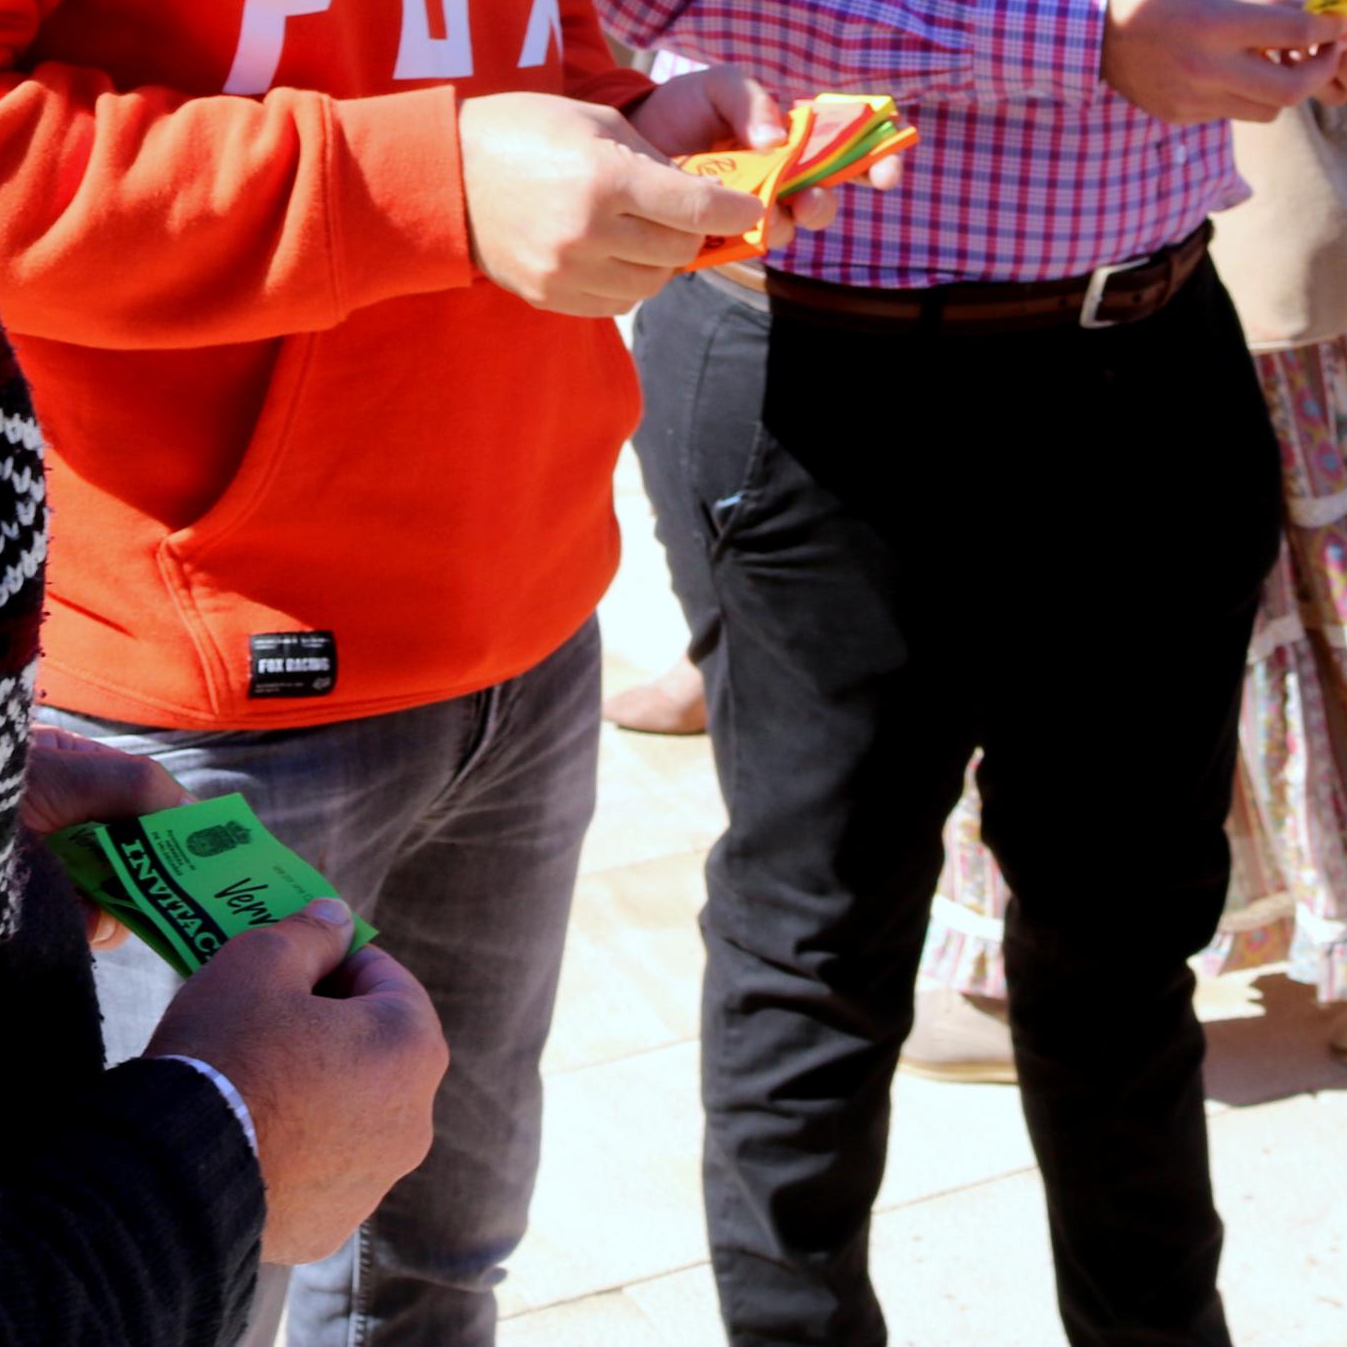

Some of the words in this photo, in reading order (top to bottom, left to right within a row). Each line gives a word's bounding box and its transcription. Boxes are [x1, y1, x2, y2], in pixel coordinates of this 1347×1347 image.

[258, 659, 284, 674] FOX
[286, 657, 330, 672] RACING
[121, 839, 221, 959] INVITAC
